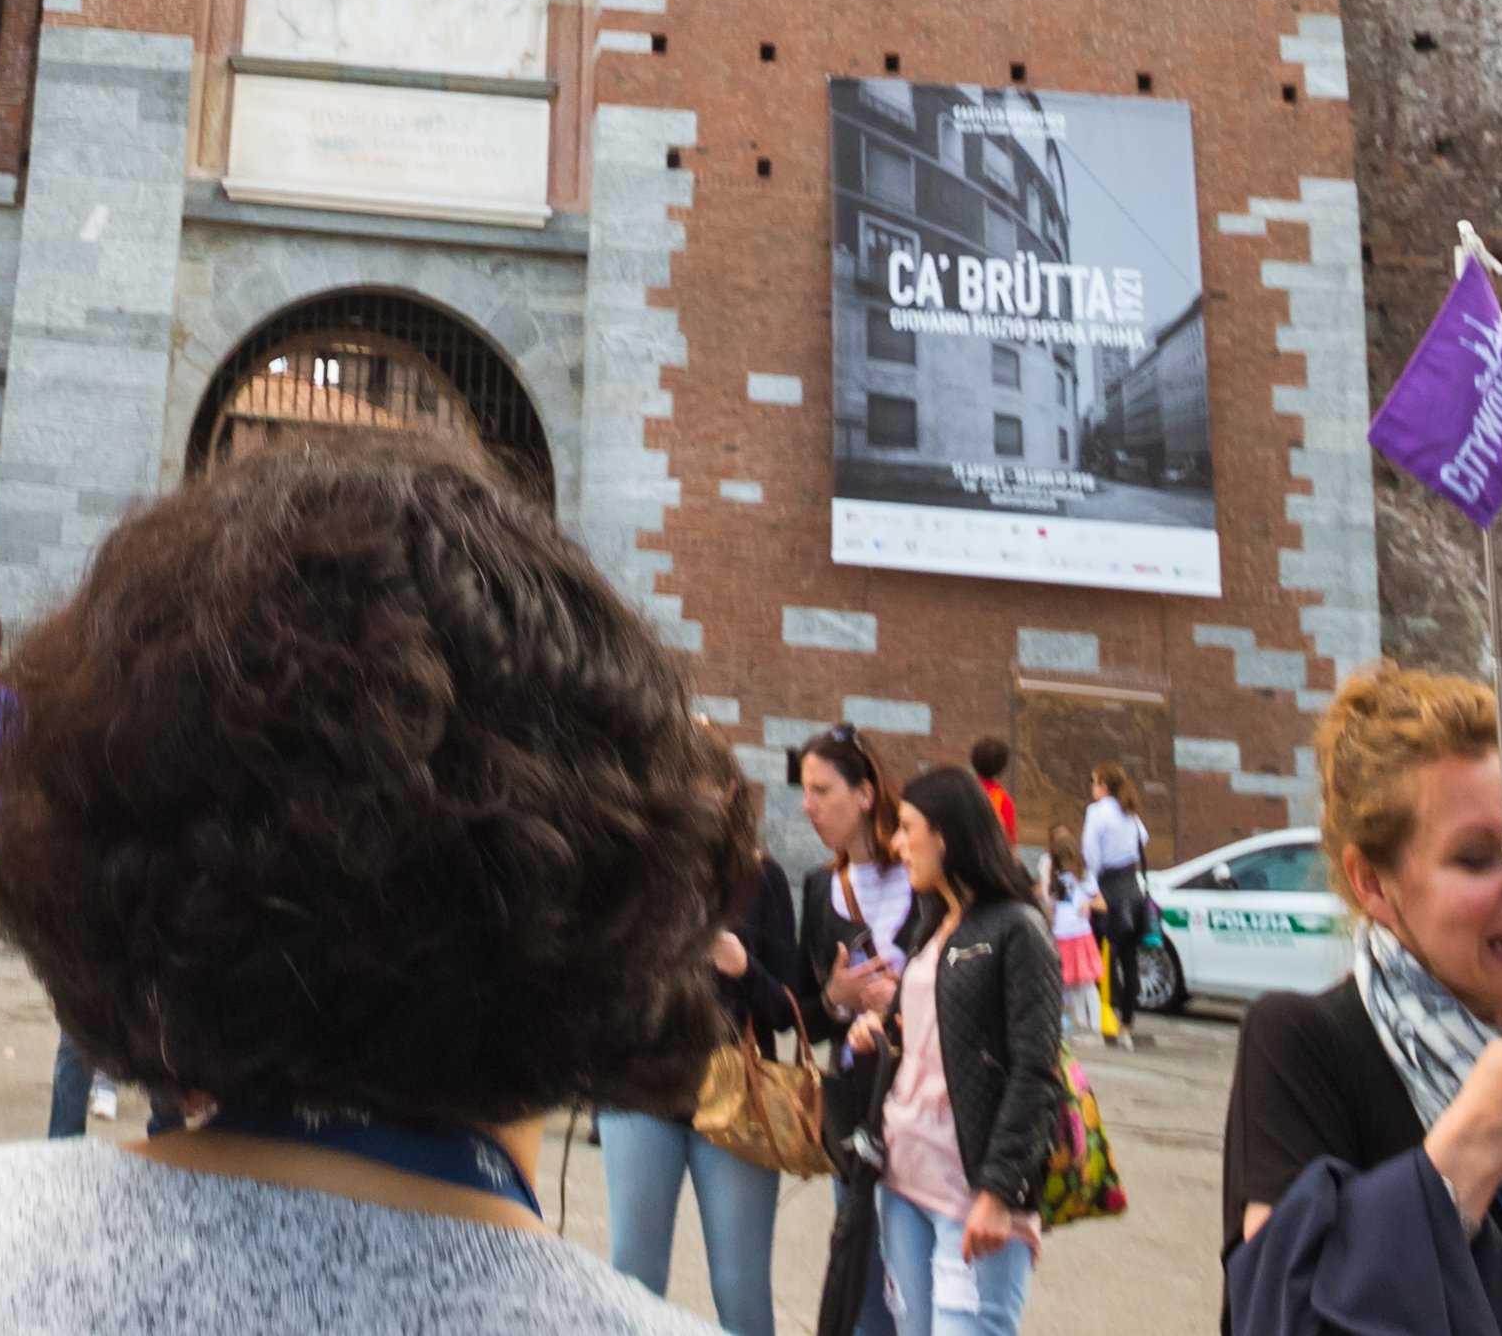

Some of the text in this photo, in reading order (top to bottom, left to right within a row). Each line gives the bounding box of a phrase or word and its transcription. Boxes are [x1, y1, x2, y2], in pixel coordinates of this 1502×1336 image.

[957, 249, 1116, 322] BRÜTTA
[1111, 267, 1144, 323] 1921
[889, 307, 1145, 350] GIOVANNI MUZIO OPERA PRIMA
[1211, 909, 1293, 933] POLIZIA
